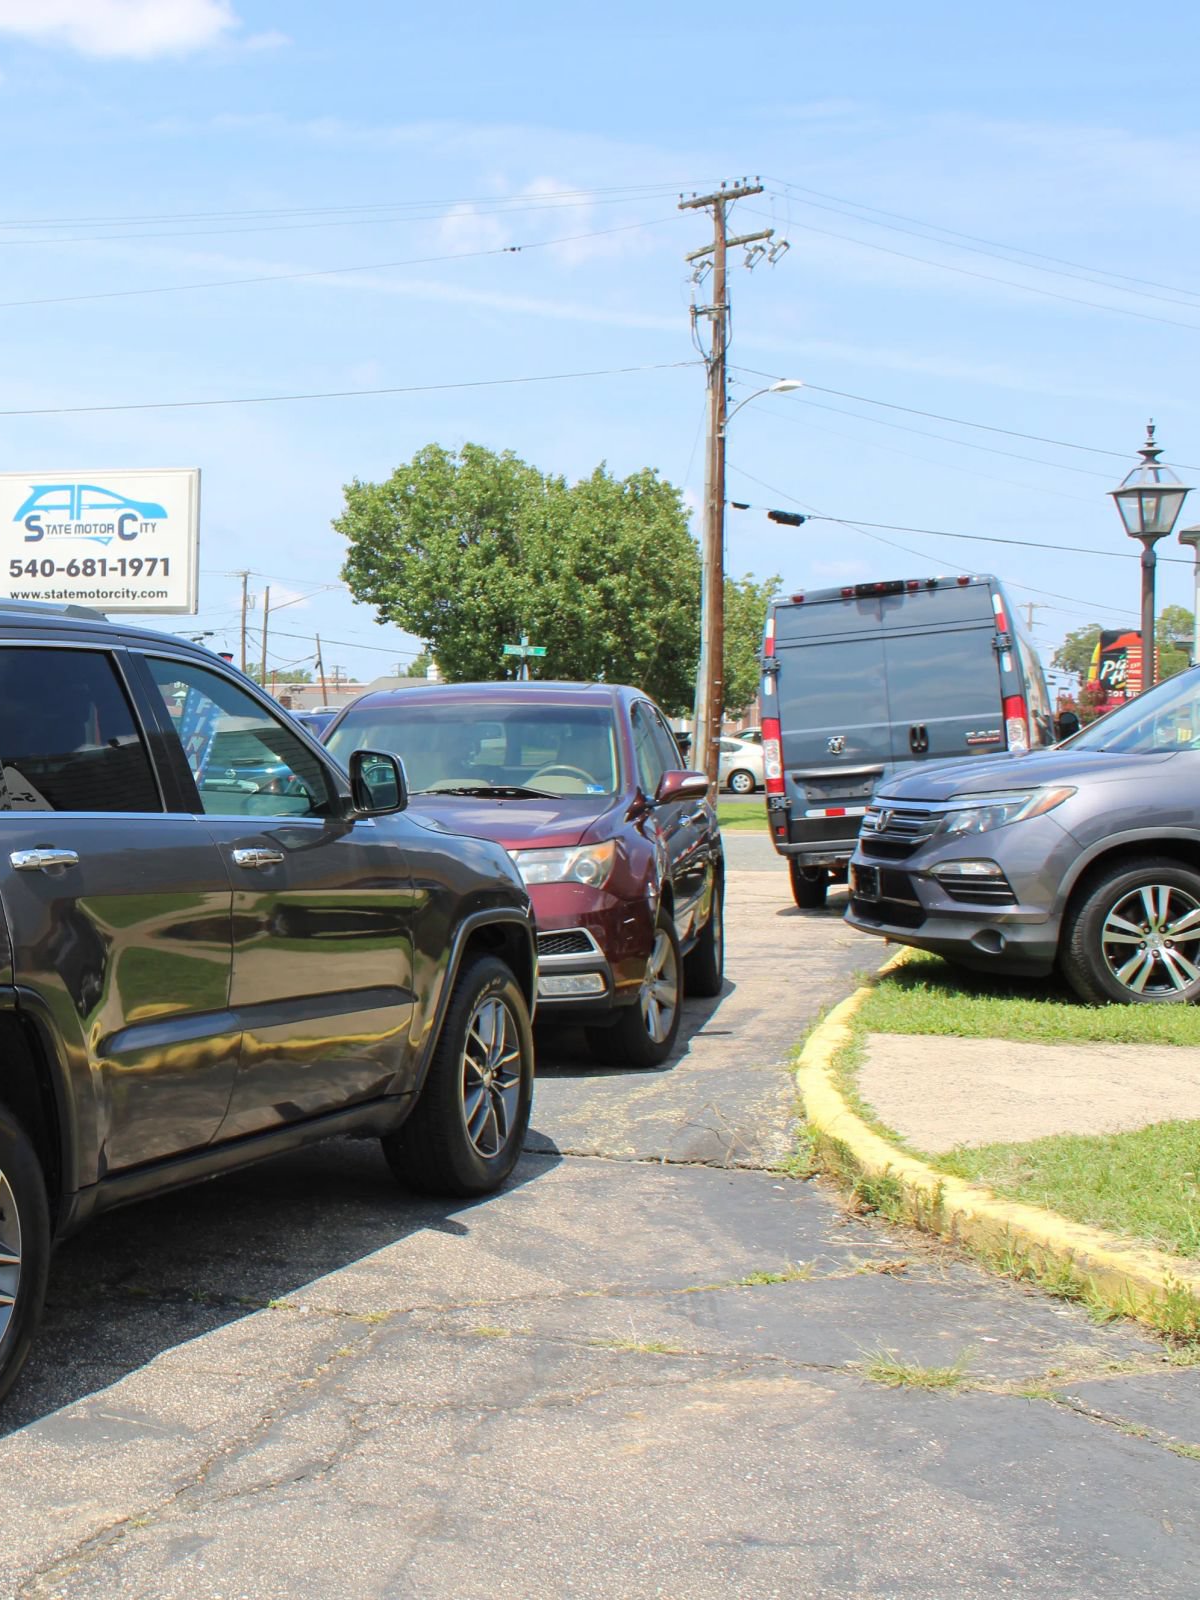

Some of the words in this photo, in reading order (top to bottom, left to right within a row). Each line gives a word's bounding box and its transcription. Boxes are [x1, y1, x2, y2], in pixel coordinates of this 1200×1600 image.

[24, 514, 72, 542] STATE
[74, 523, 115, 535] MOTOR
[118, 513, 157, 541] CITY
[9, 557, 170, 578] 540-681-1971
[10, 588, 168, 600] www.statemotorcity.com
